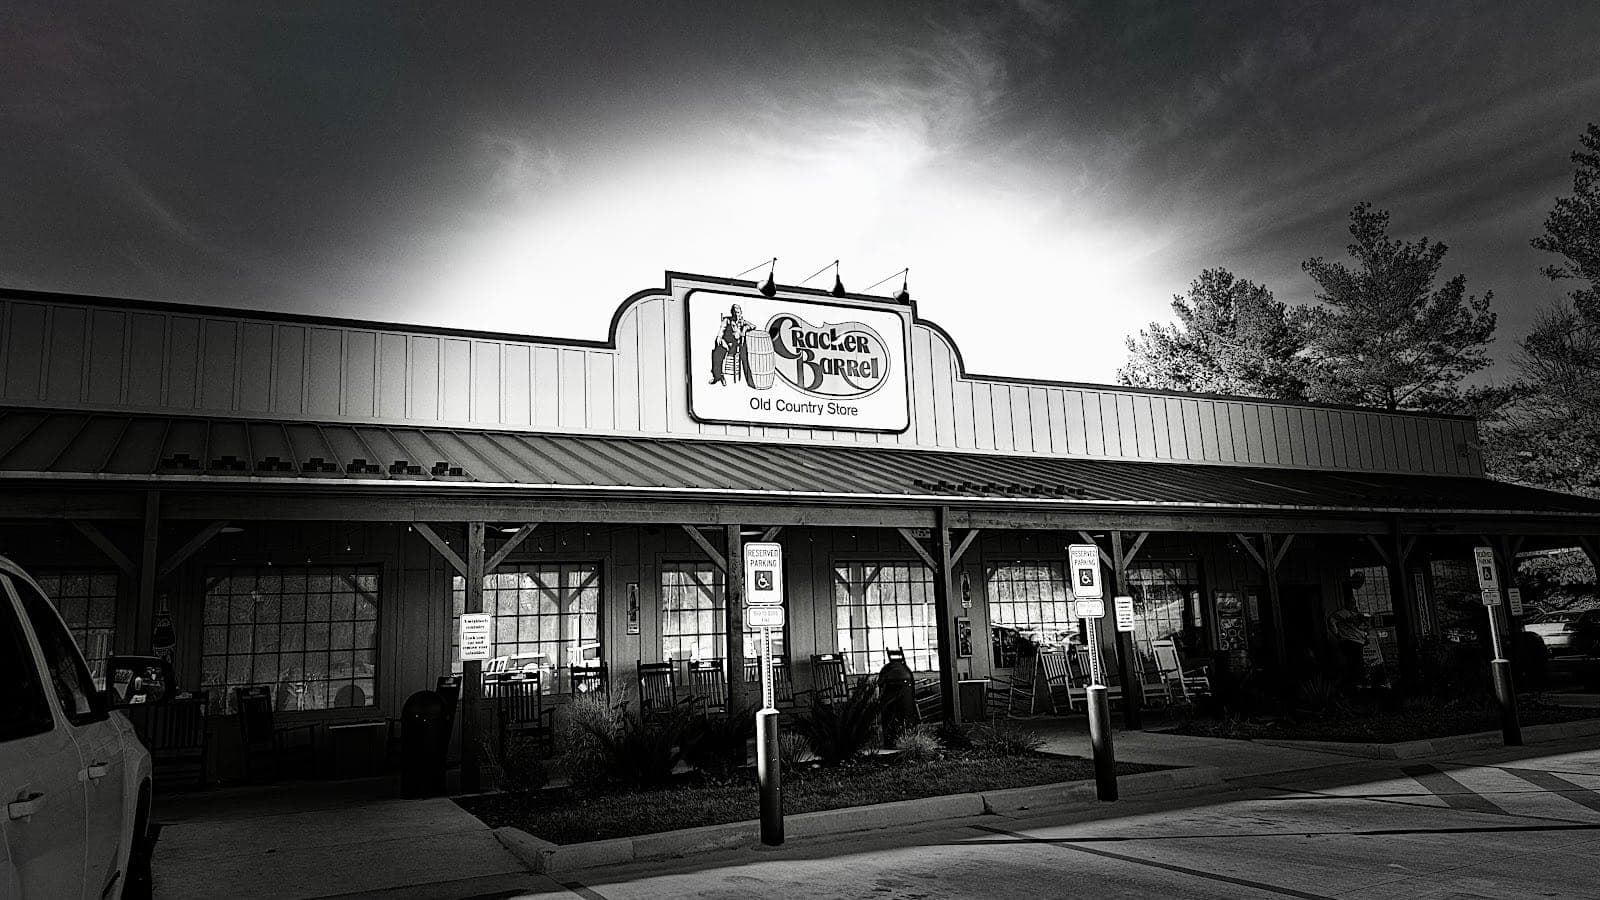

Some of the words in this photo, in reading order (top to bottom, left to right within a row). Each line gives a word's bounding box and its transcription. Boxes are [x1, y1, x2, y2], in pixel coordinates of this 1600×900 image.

[769, 316, 870, 359] Cracker
[796, 348, 879, 390] Barrel
[750, 397, 771, 411] Old
[775, 399, 824, 416] Country
[827, 402, 858, 416] Store
[747, 549, 779, 558] RESERVED
[750, 559, 777, 568] PARKING
